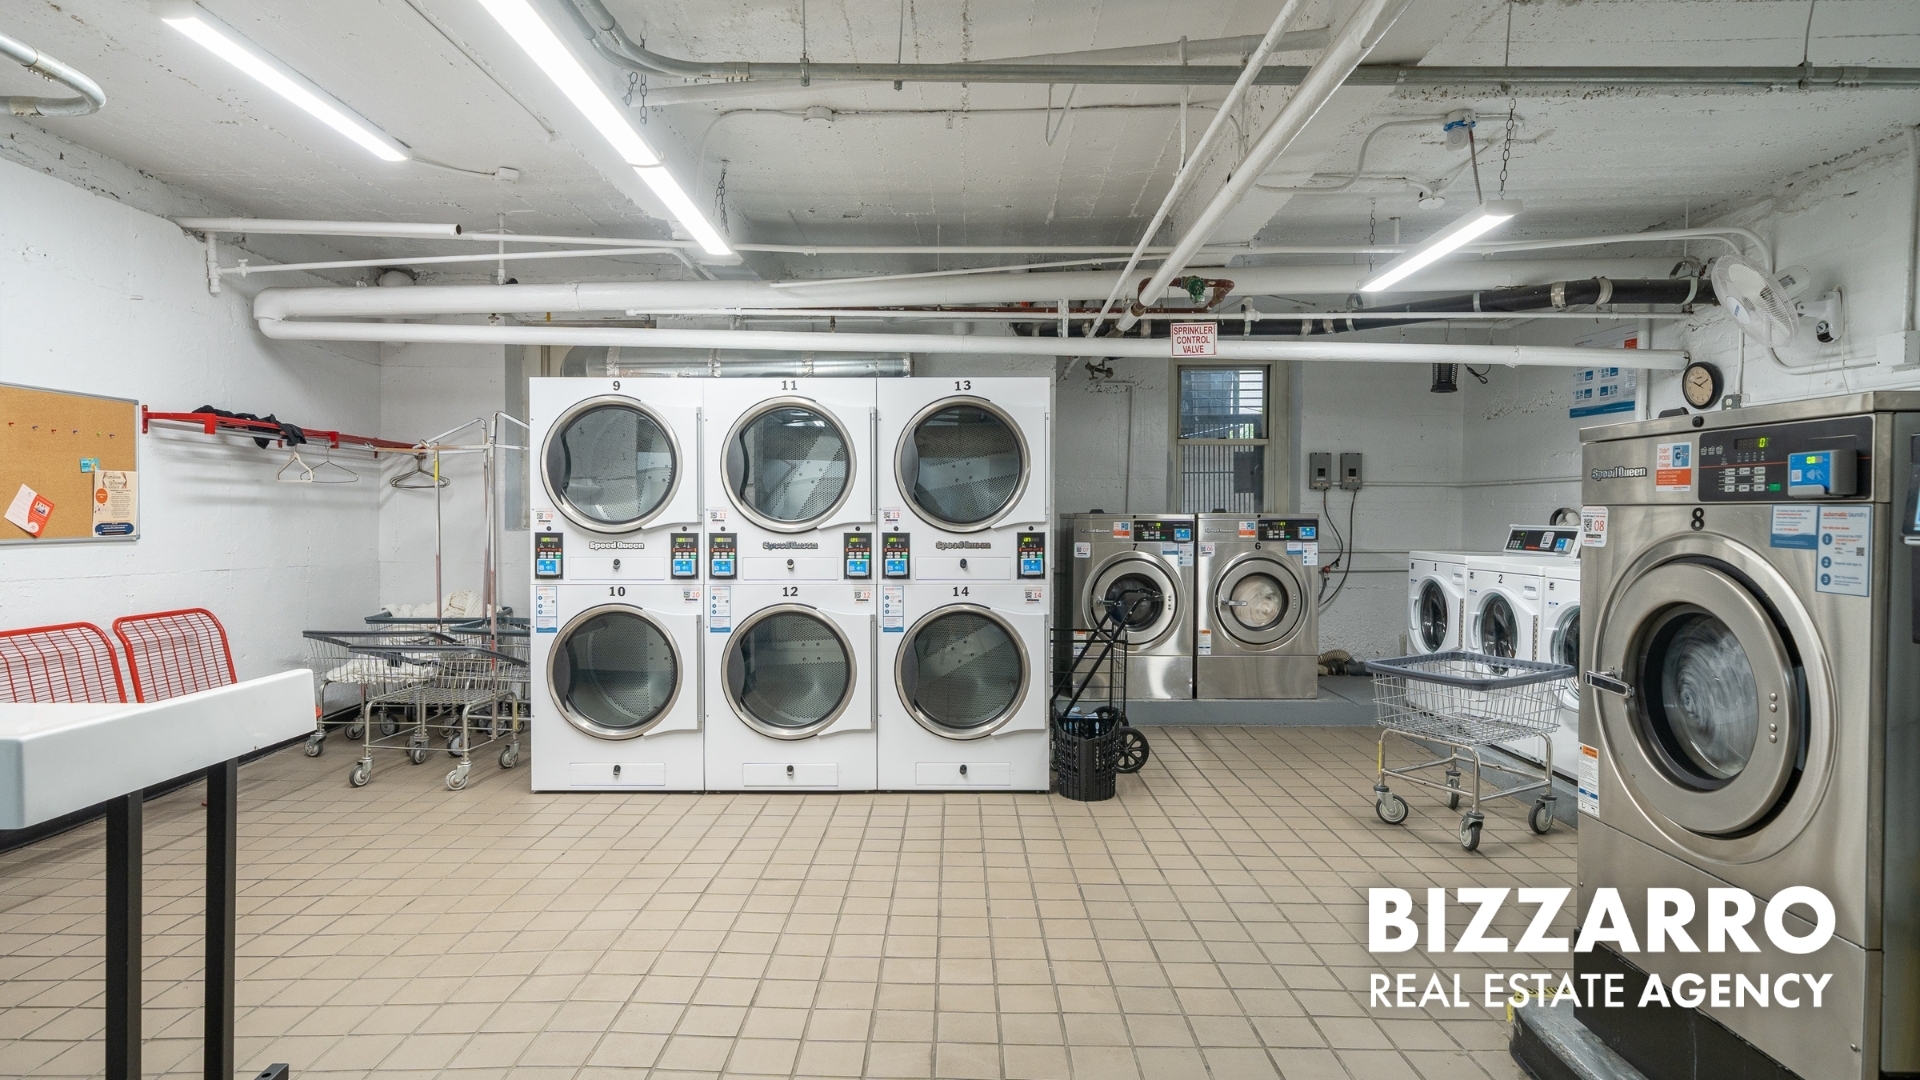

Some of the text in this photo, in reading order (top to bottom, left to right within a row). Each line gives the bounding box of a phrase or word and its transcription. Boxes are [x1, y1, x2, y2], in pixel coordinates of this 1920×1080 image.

[1173, 326, 1213, 335] SPRINKLER
[1176, 336, 1210, 344] CONTROL
[1182, 345, 1204, 353] VALVE
[612, 380, 621, 391] 9
[781, 380, 798, 391] 11
[954, 380, 972, 391] 13
[1591, 466, 1647, 481] Speed Queen
[1691, 507, 1705, 531] 8
[1593, 520, 1605, 531] 08
[589, 541, 645, 551] Speed Queen
[1132, 543, 1138, 551] 7
[1254, 542, 1262, 550] 6
[1433, 562, 1437, 571] 1
[1498, 574, 1503, 584] 2
[609, 586, 626, 597] 10
[782, 586, 798, 597] 12
[952, 586, 969, 597] 14
